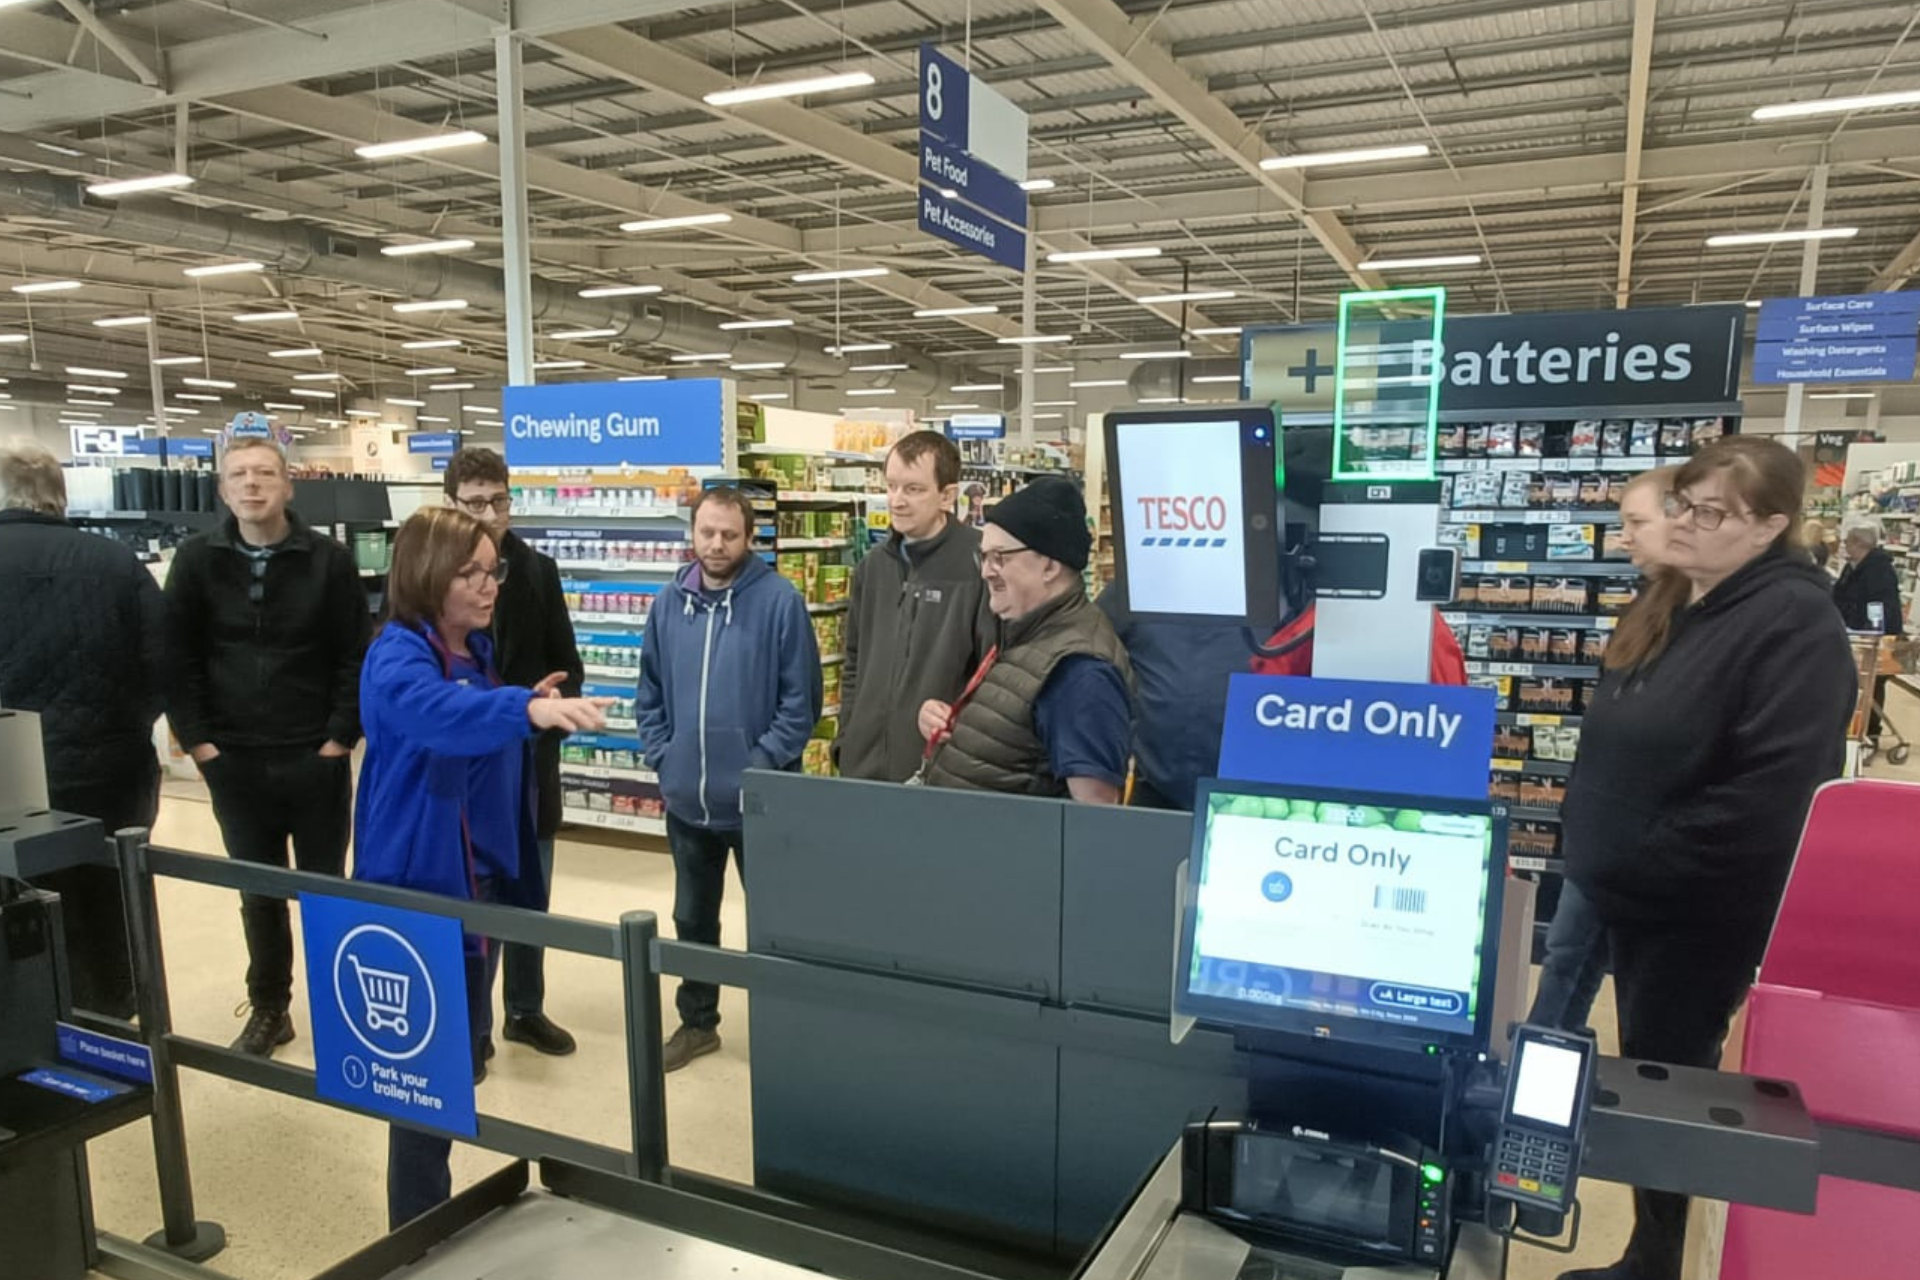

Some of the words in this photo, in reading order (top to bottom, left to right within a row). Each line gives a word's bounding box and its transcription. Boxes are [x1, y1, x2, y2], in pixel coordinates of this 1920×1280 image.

[926, 62, 942, 120] 8
[925, 147, 942, 173] Pet
[943, 157, 968, 187] Food
[924, 199, 941, 225] Pet
[942, 208, 995, 248] Accessories
[1805, 302, 1845, 312] Surface
[1847, 301, 1874, 310] Care
[1799, 324, 1839, 334] Surface
[1841, 323, 1874, 332] Wipes
[1411, 331, 1693, 387] Batteries
[1782, 346, 1826, 357] Washing
[1827, 345, 1887, 356] Detergents
[1776, 368, 1832, 379] Household
[1833, 366, 1887, 376] Essentials
[511, 414, 602, 444] Chewing
[606, 413, 660, 438] Gum
[1820, 433, 1844, 446] Veg
[1137, 495, 1227, 532] TESCO
[1255, 694, 1352, 732] Card
[1363, 700, 1463, 748] Only
[1275, 836, 1339, 864] Card
[1347, 843, 1412, 876] Only
[1397, 991, 1427, 1007] Large
[1429, 997, 1453, 1009] text
[126, 1052, 146, 1068] here
[371, 1062, 399, 1082] Park
[400, 1070, 428, 1088] your
[373, 1080, 411, 1104] trolley
[413, 1090, 442, 1110] here
